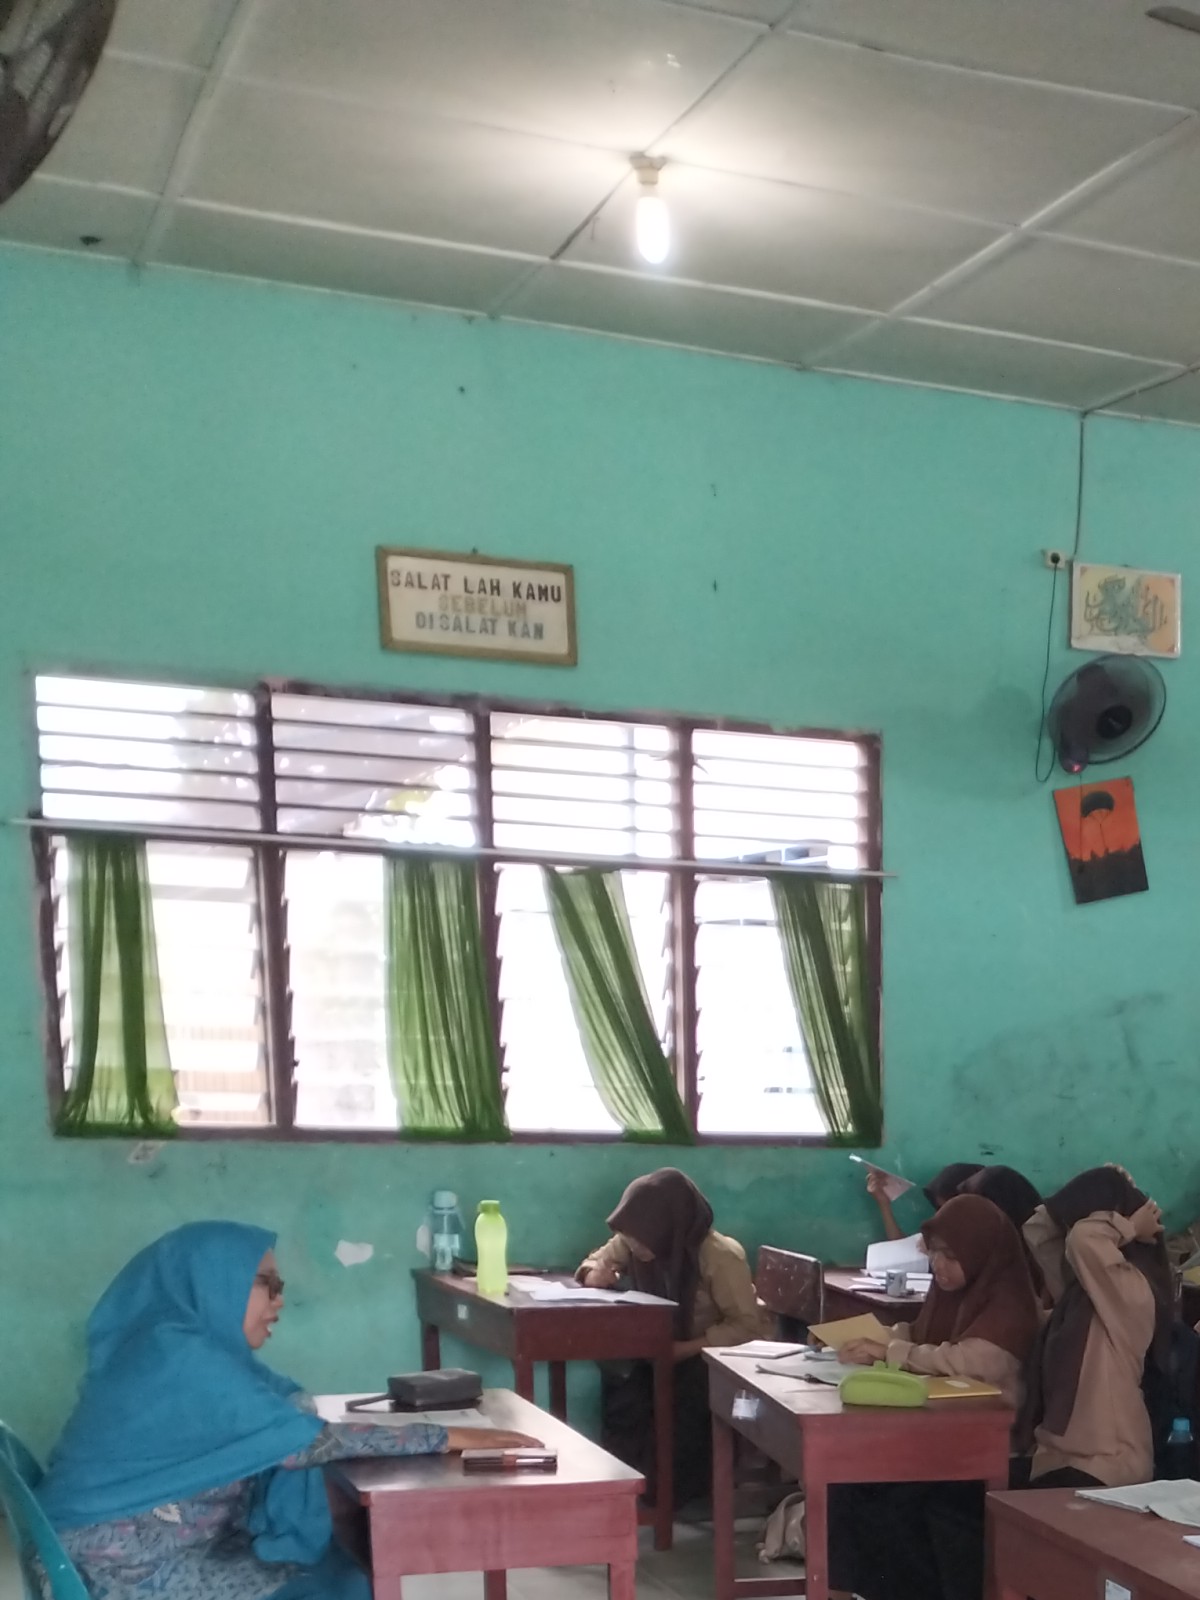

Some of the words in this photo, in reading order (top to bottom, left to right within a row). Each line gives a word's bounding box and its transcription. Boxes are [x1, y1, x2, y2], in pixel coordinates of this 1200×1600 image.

[390, 569, 451, 591] SALAT
[463, 576, 501, 597] LAH
[511, 581, 562, 602] KAMU
[507, 621, 544, 640] KAN
